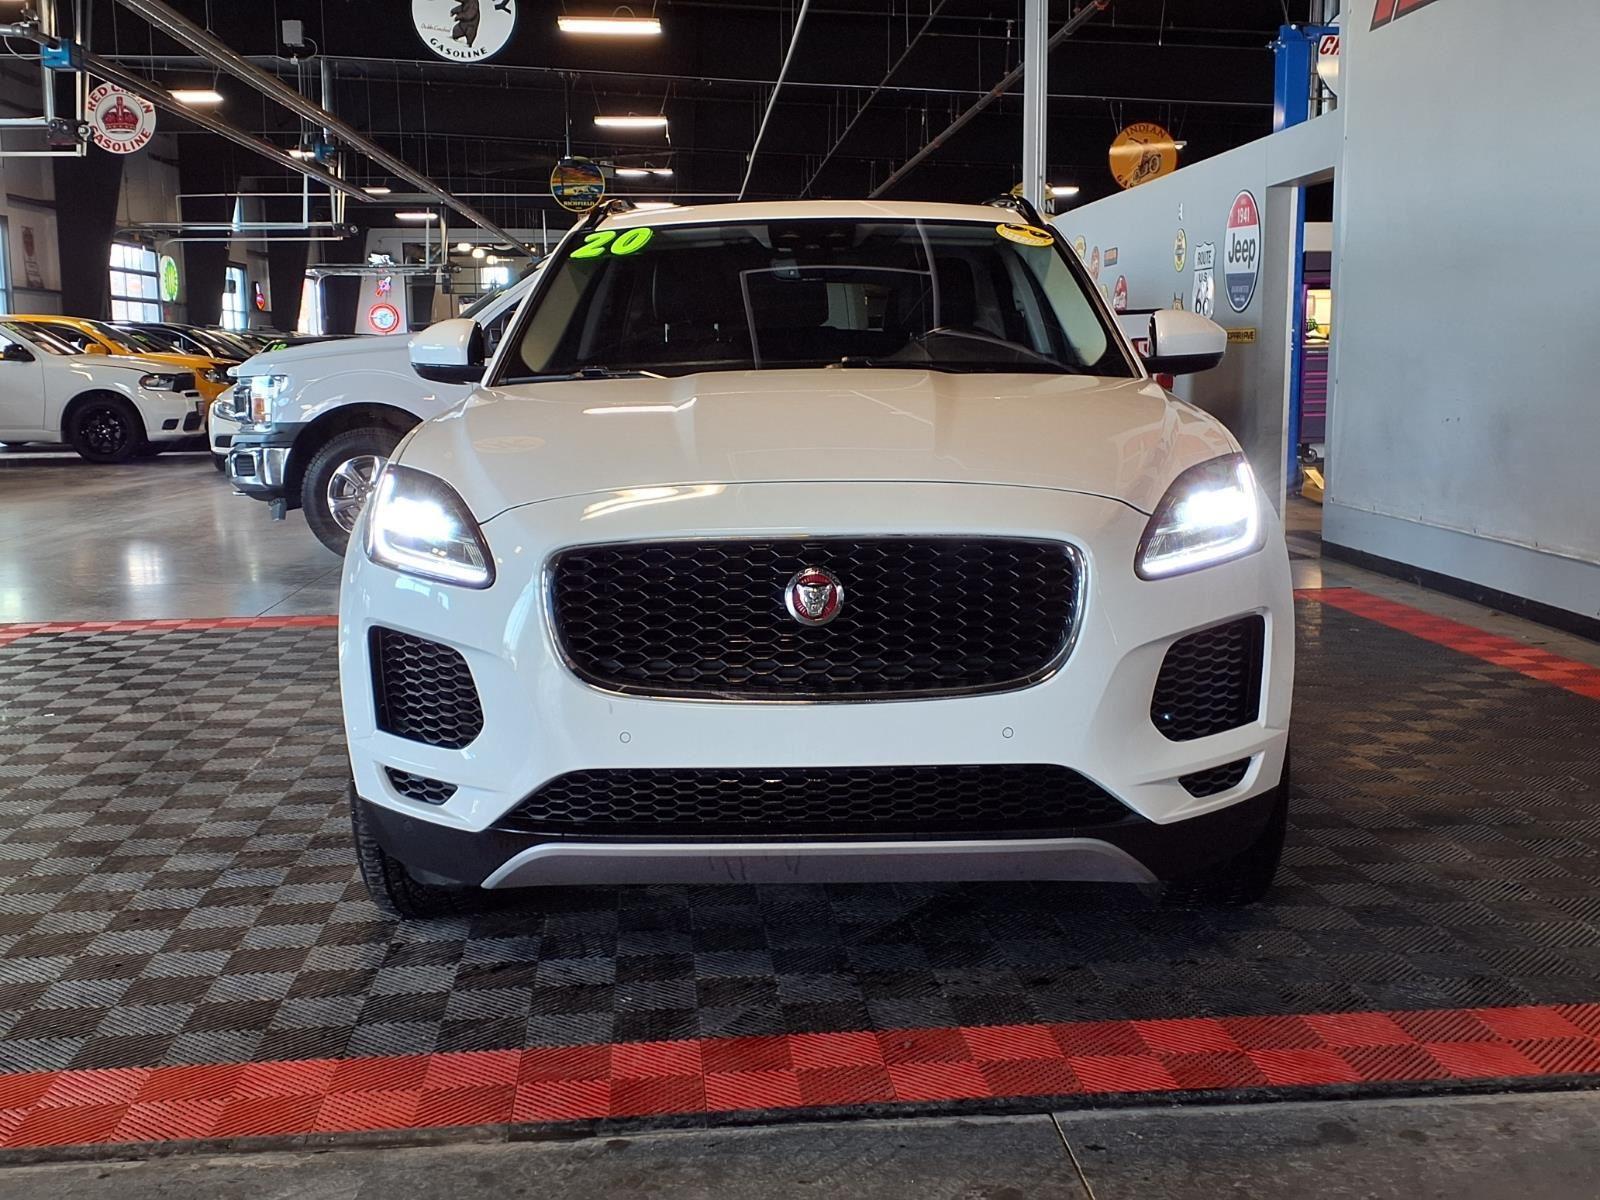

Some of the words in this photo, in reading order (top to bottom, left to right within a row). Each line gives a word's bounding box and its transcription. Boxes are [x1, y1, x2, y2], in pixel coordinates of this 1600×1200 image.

[430, 38, 488, 58] GASOLINE
[88, 86, 108, 112] RED
[1125, 124, 1166, 139] INDIAN
[1237, 207, 1250, 224] 1941
[569, 227, 654, 258] 20
[1228, 233, 1256, 269] Jeep
[1198, 250, 1212, 265] ROUTE
